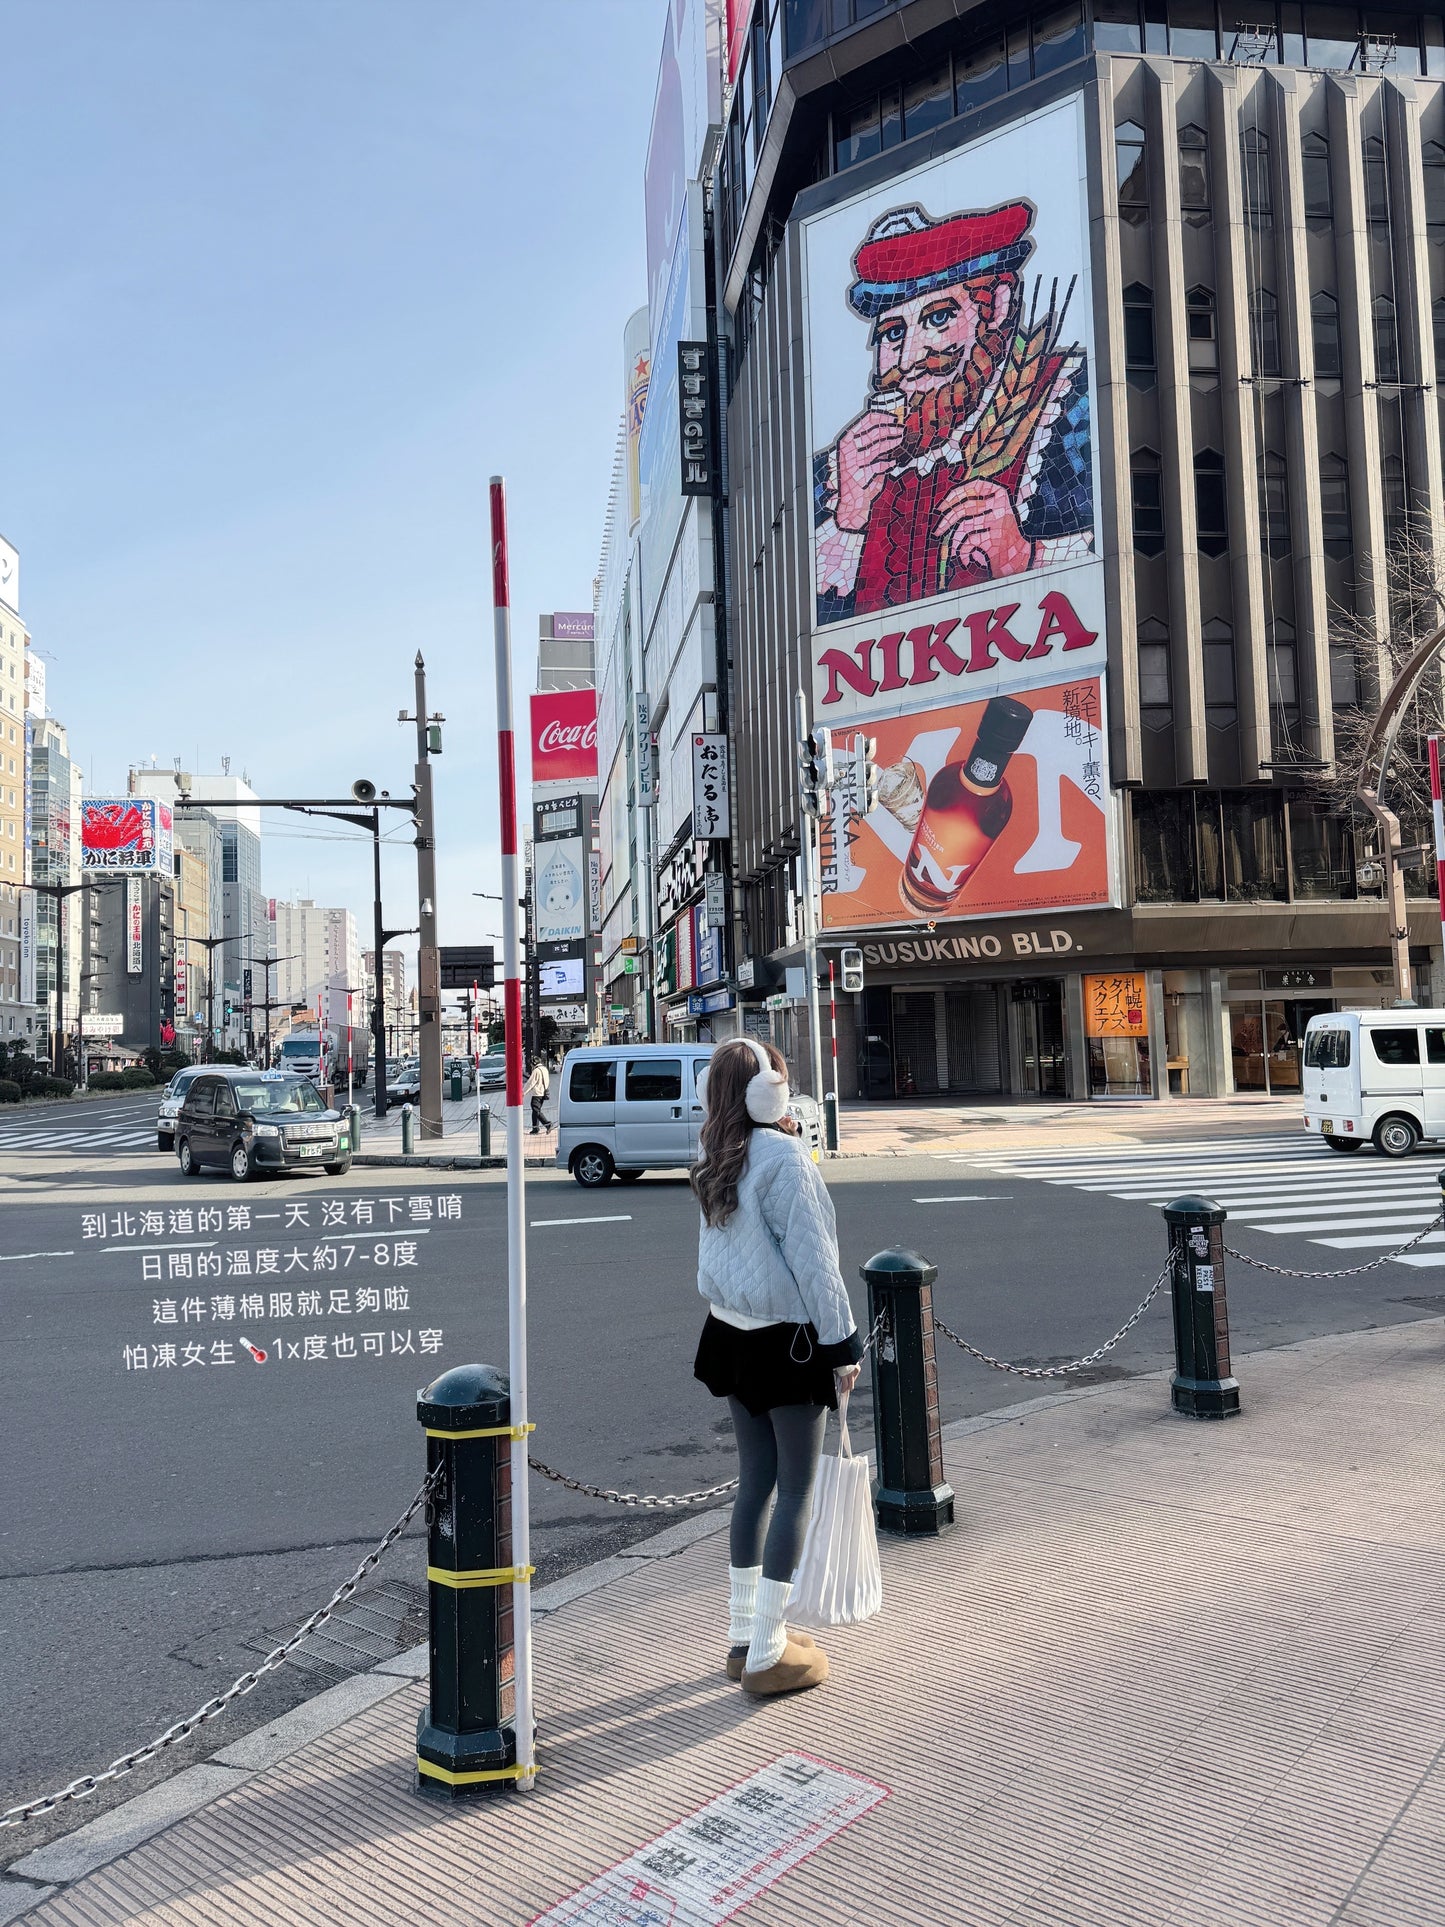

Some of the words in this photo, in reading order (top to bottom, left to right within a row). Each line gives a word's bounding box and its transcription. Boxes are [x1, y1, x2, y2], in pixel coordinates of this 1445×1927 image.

[681, 347, 708, 483] すすきのビル
[817, 590, 1099, 705] NIKKA
[538, 719, 598, 753] Coca-C
[1062, 688, 1083, 746] 新境地。
[1080, 685, 1102, 800] スモーキー薫る、
[639, 732, 650, 794] グリーンビル
[700, 744, 720, 834] おたる亭
[85, 850, 152, 866] かに将軍
[591, 879, 600, 923] グリーンビル
[21, 918, 30, 944] toyoko
[548, 926, 581, 936] DAIKIN
[864, 935, 1002, 964] SUSUKINO
[1011, 930, 1083, 955] BLD.
[1093, 979, 1109, 1031] スクエア
[1109, 978, 1127, 1029] タイムズ
[1124, 977, 1142, 1009] 札幌
